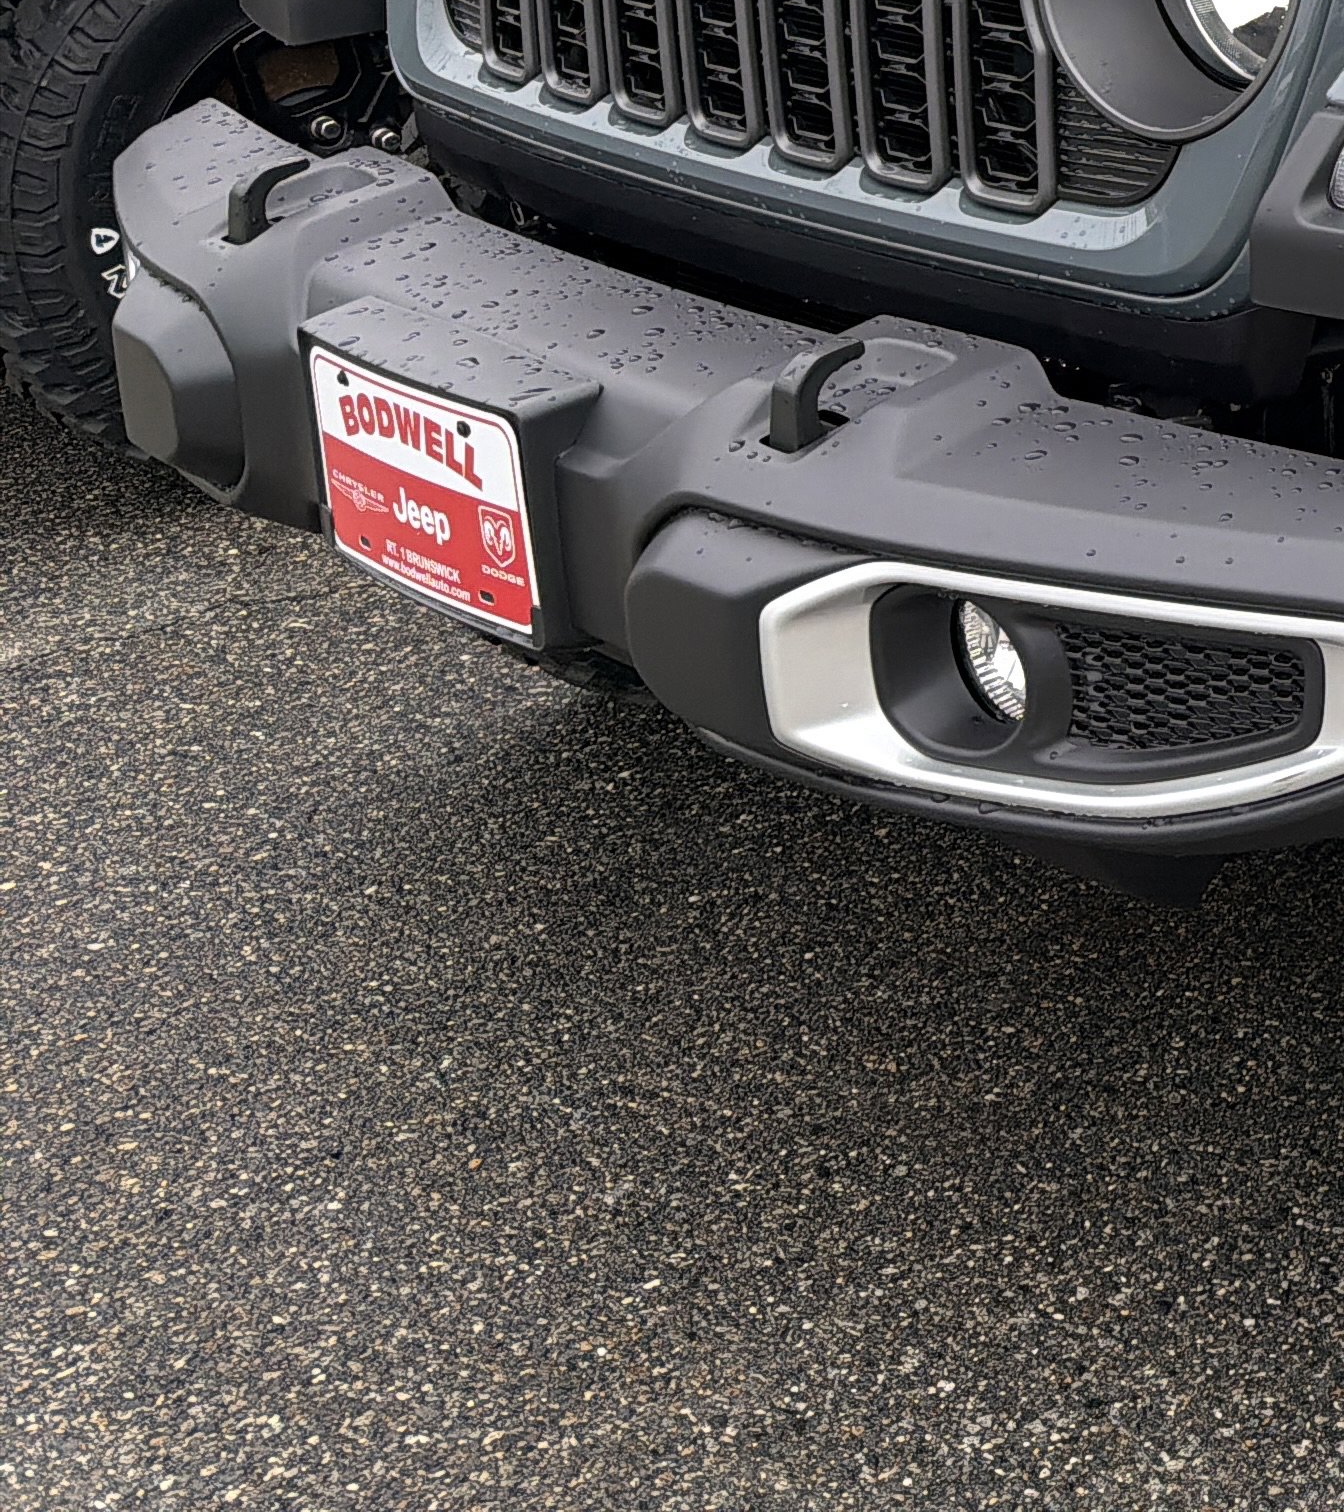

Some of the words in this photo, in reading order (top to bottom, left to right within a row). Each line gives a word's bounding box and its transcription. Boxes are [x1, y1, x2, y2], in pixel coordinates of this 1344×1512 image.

[338, 392, 483, 492] BODWELL
[332, 468, 385, 504] CHRYSLER
[392, 487, 451, 546] Jeep
[405, 548, 462, 585] BRUNSWICK
[480, 564, 526, 587] DODGE
